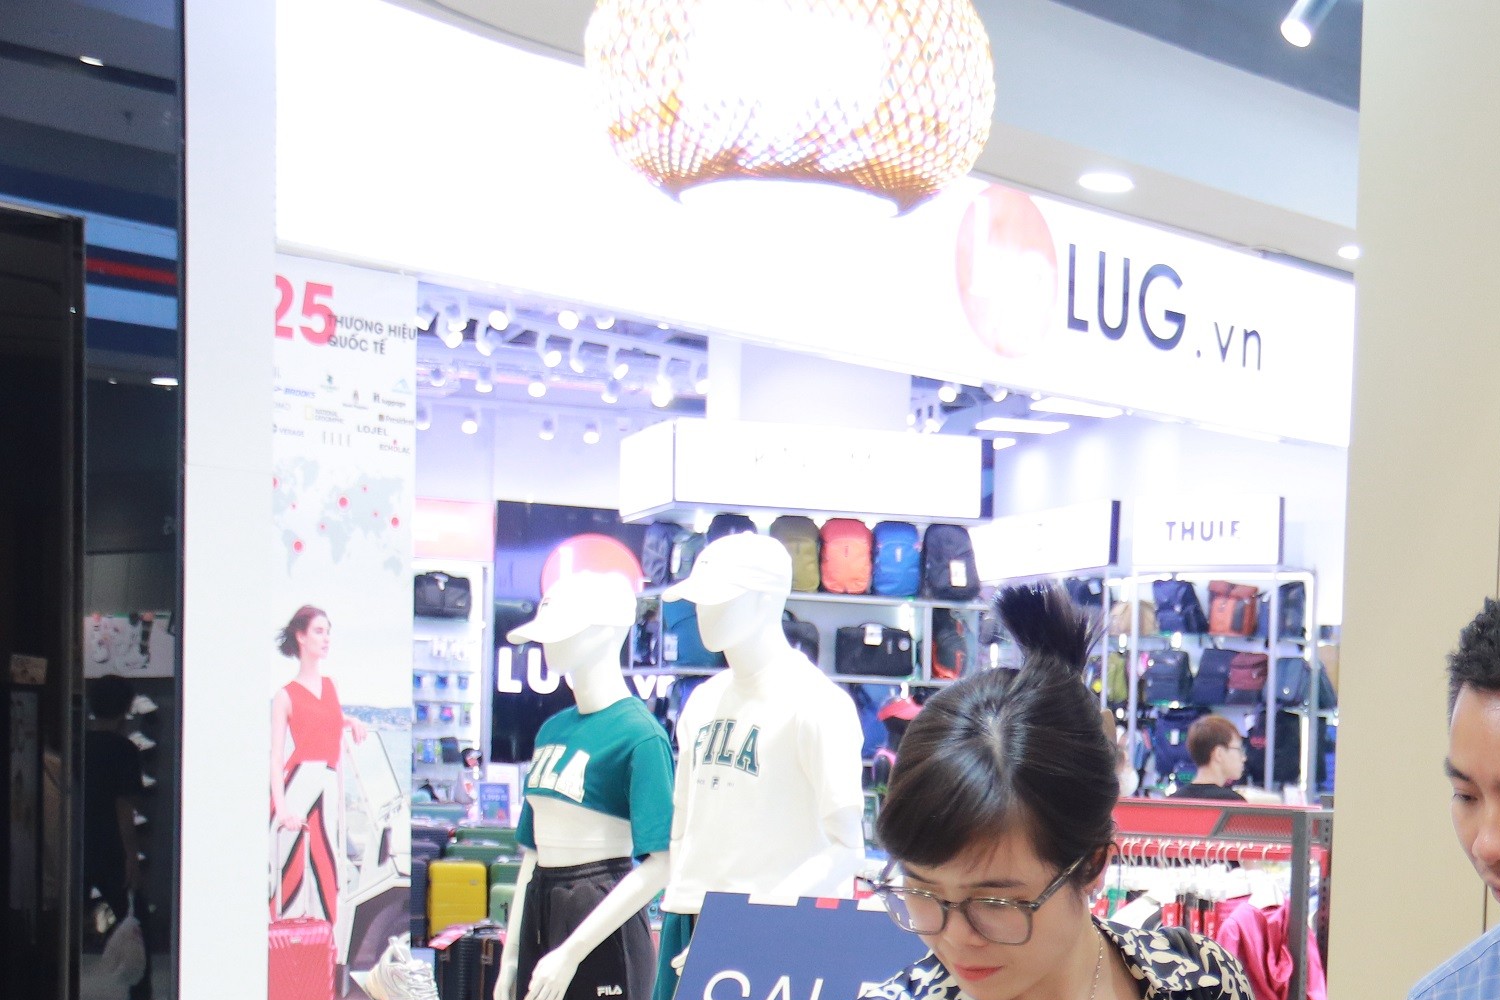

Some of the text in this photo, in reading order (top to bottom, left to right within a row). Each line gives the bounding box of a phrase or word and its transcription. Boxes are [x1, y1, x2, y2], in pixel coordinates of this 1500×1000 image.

[275, 274, 336, 345] 25
[1067, 243, 1261, 371] LUG.vn
[328, 333, 369, 352] QUỐC
[597, 984, 623, 997] FILA
